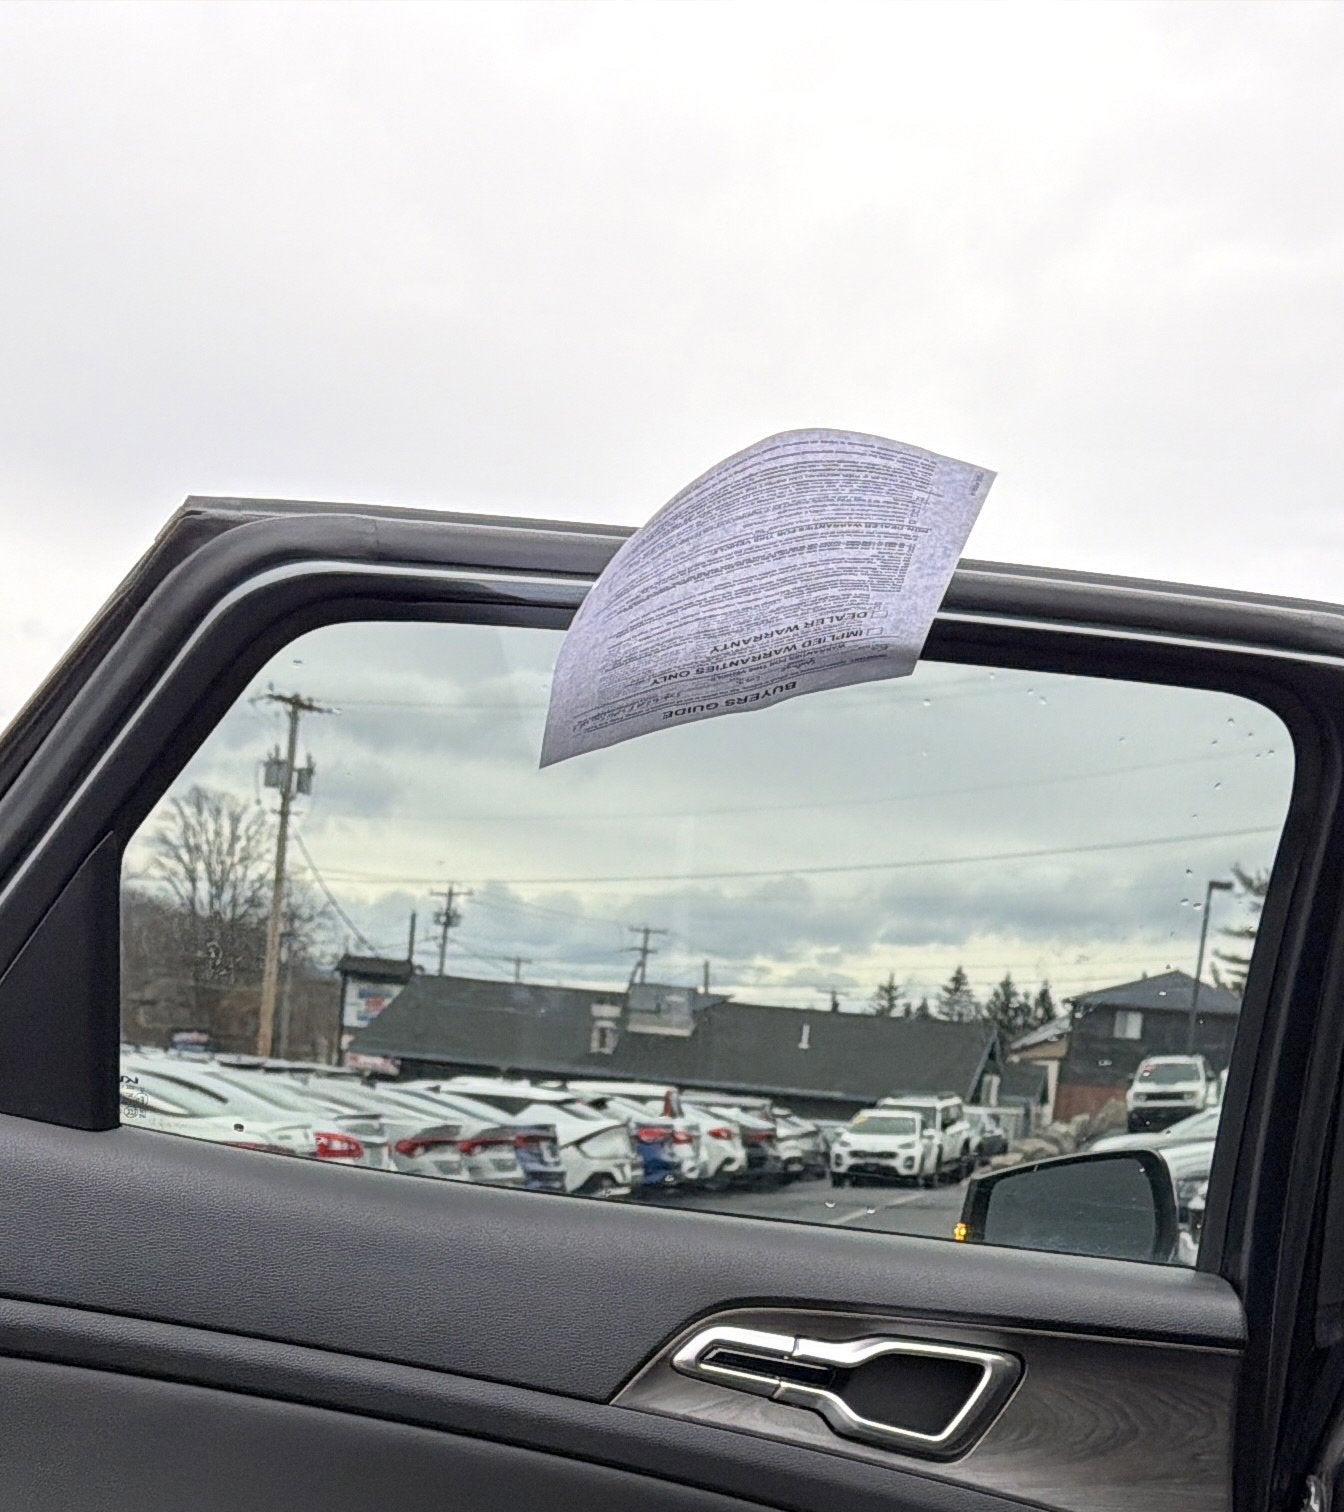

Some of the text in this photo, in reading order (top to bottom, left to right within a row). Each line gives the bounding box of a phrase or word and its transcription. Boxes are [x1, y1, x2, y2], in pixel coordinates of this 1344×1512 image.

[709, 611, 868, 654] DEALER WARRANTY
[801, 629, 863, 648] IMPLIED
[696, 645, 797, 675] WARRANTIES
[651, 670, 691, 685] ONLY
[725, 681, 797, 706] BUYERS
[662, 702, 719, 720] GUIDE
